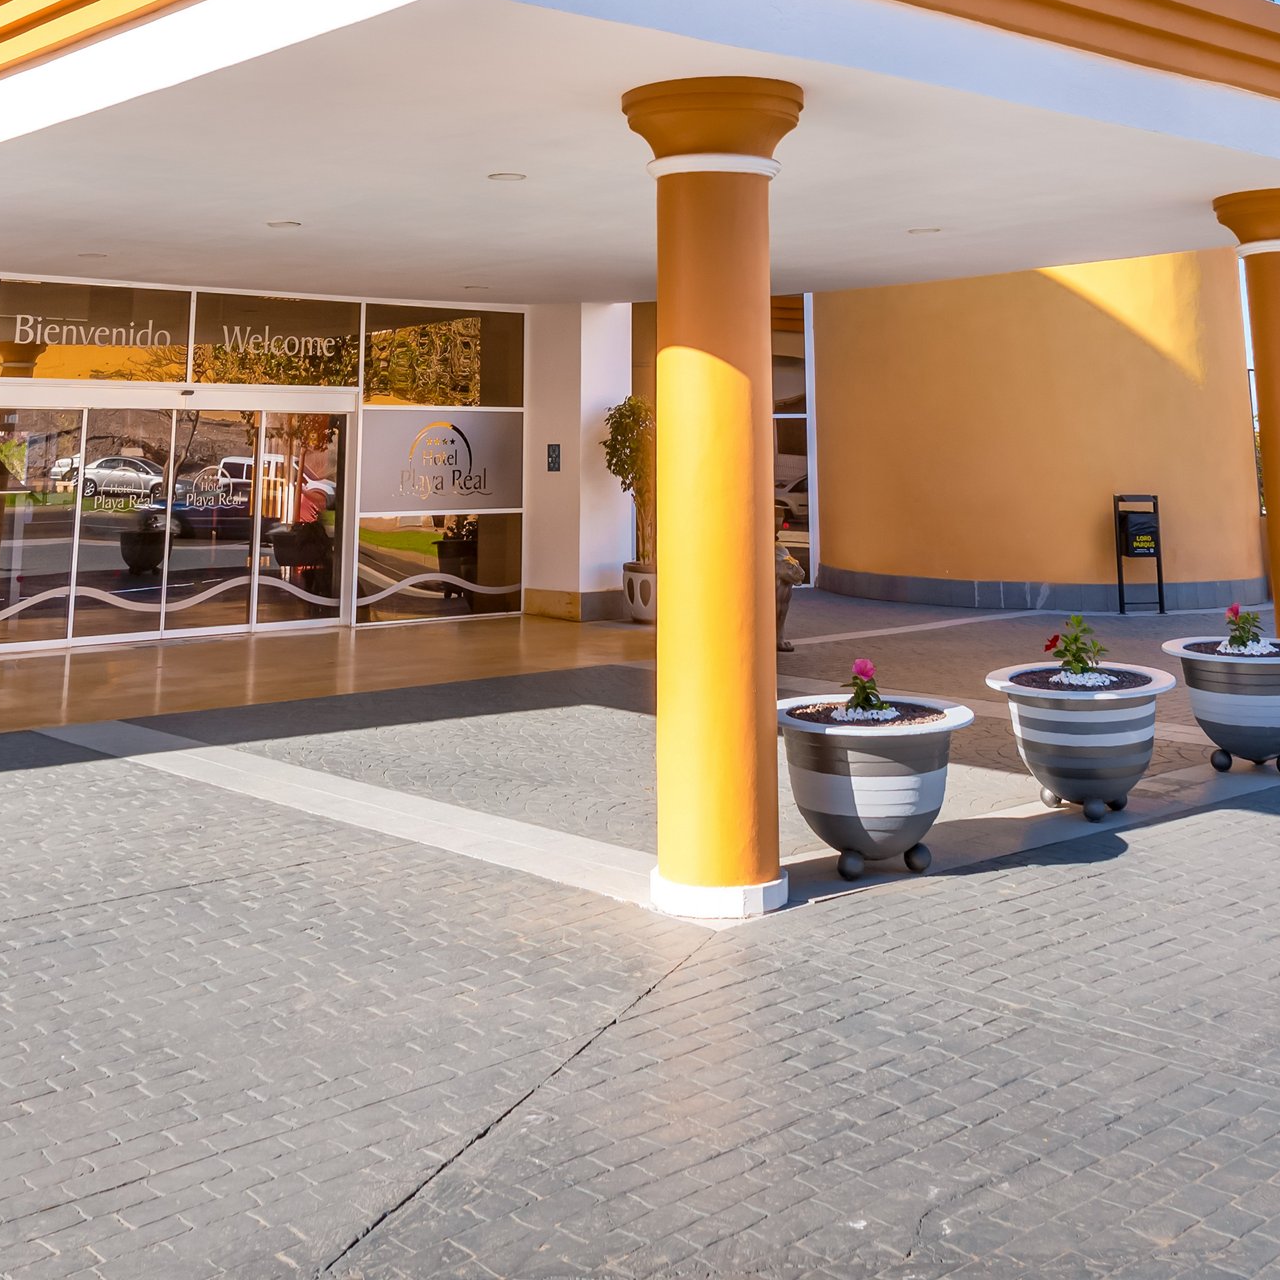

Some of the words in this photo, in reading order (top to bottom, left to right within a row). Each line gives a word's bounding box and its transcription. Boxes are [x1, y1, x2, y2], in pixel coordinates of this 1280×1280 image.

[13, 314, 172, 349] Bienvenido
[222, 324, 336, 358] Welcome
[422, 449, 458, 466] Hotel
[110, 483, 135, 494] Hotel
[199, 481, 224, 493] Hotel
[400, 467, 444, 499] Playa
[452, 467, 487, 490] Real
[94, 494, 124, 513] Playa
[129, 493, 154, 508] Real
[186, 492, 215, 510] Playa
[219, 491, 243, 506] Real
